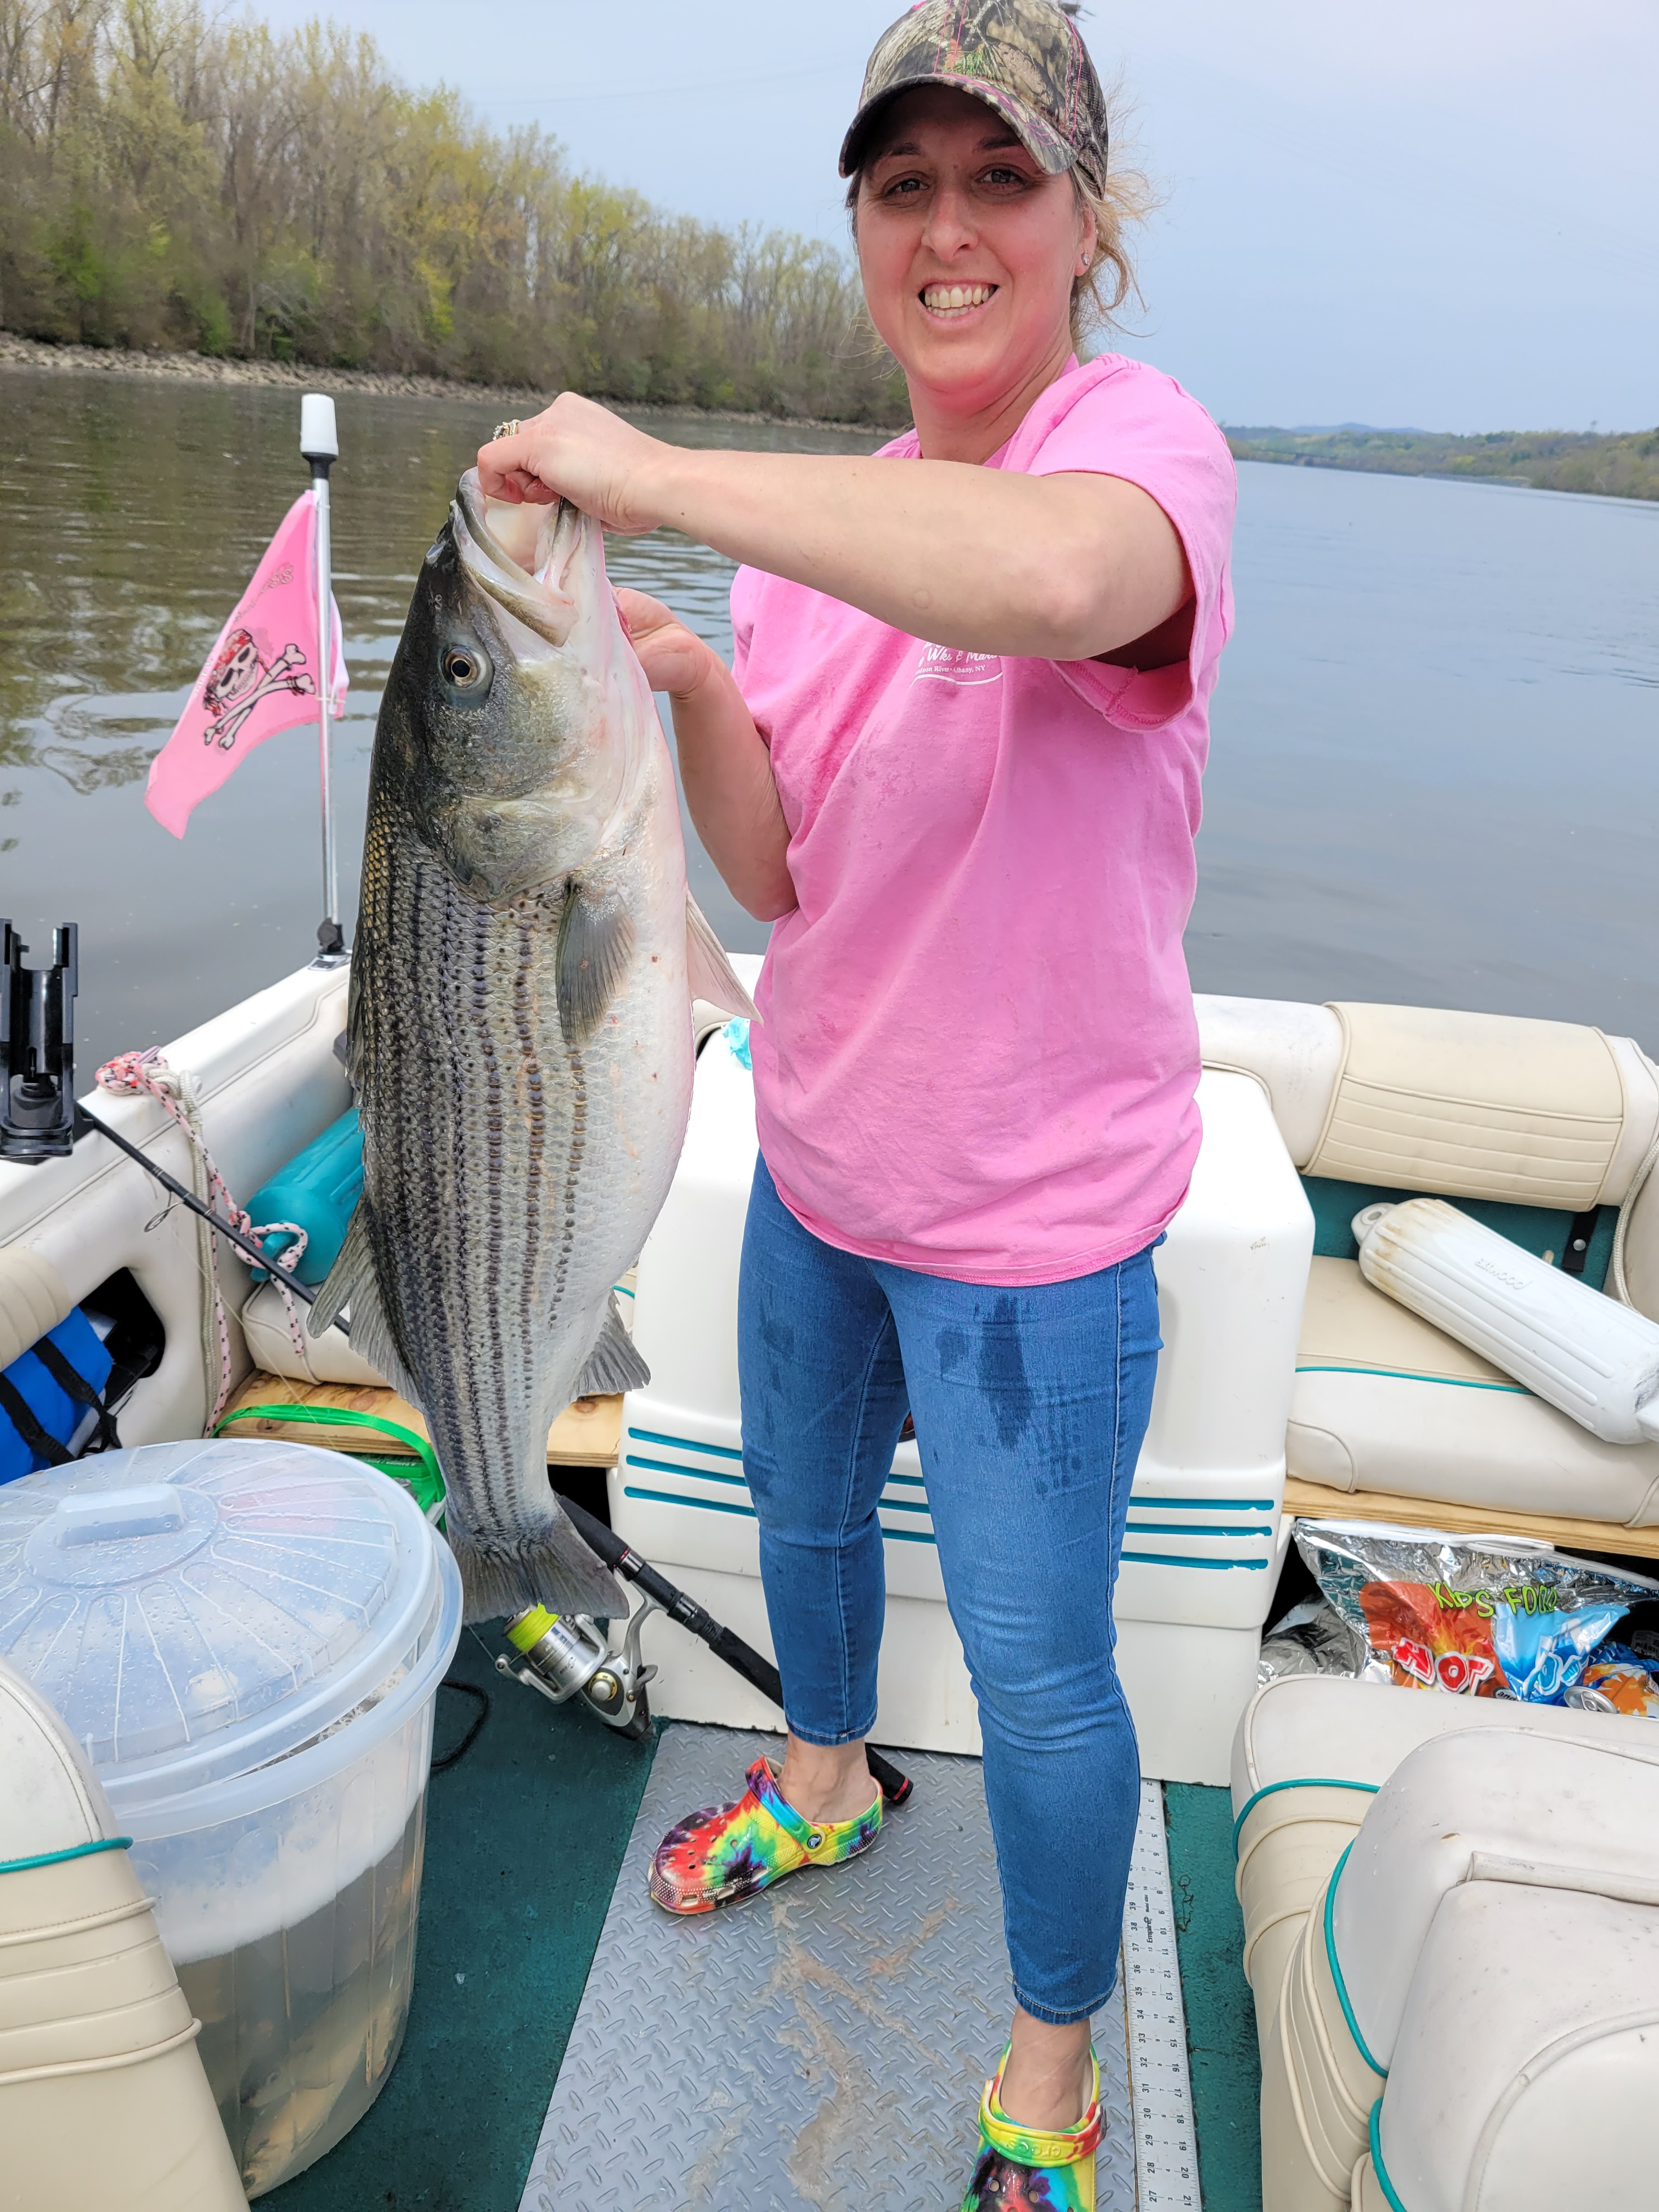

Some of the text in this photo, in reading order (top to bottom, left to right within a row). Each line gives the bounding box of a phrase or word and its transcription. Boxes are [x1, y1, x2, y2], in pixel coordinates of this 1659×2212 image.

[1426, 1581, 1494, 1618] KIDS
[1391, 1637, 1494, 1696] HOT
[1128, 1882, 1135, 1891] 40
[1130, 1902, 1136, 1910] 39
[1131, 1922, 1138, 1931] 38
[1160, 1927, 1167, 1935] 10
[1132, 1943, 1139, 1952] 37
[1134, 1965, 1141, 1973] 36
[1136, 1987, 1142, 1996] 35
[1137, 2010, 1144, 2019] 34
[1168, 2015, 1175, 2023] 14
[1138, 2033, 1146, 2043] 33
[1170, 2038, 1177, 2047] 15
[1140, 2057, 1148, 2068] 32
[1172, 2063, 1180, 2072] 16
[1142, 2083, 1150, 2093] 31
[1174, 2089, 1182, 2097] 17
[1144, 2108, 1152, 2119] 30
[1177, 2114, 1184, 2124] 18
[1146, 2134, 1153, 2146] 29
[1178, 2141, 1186, 2151] 19
[1147, 2162, 1155, 2174] 28
[1181, 2166, 1189, 2179] 20
[1149, 2190, 1157, 2202] 27
[1183, 2195, 1192, 2207] 21
